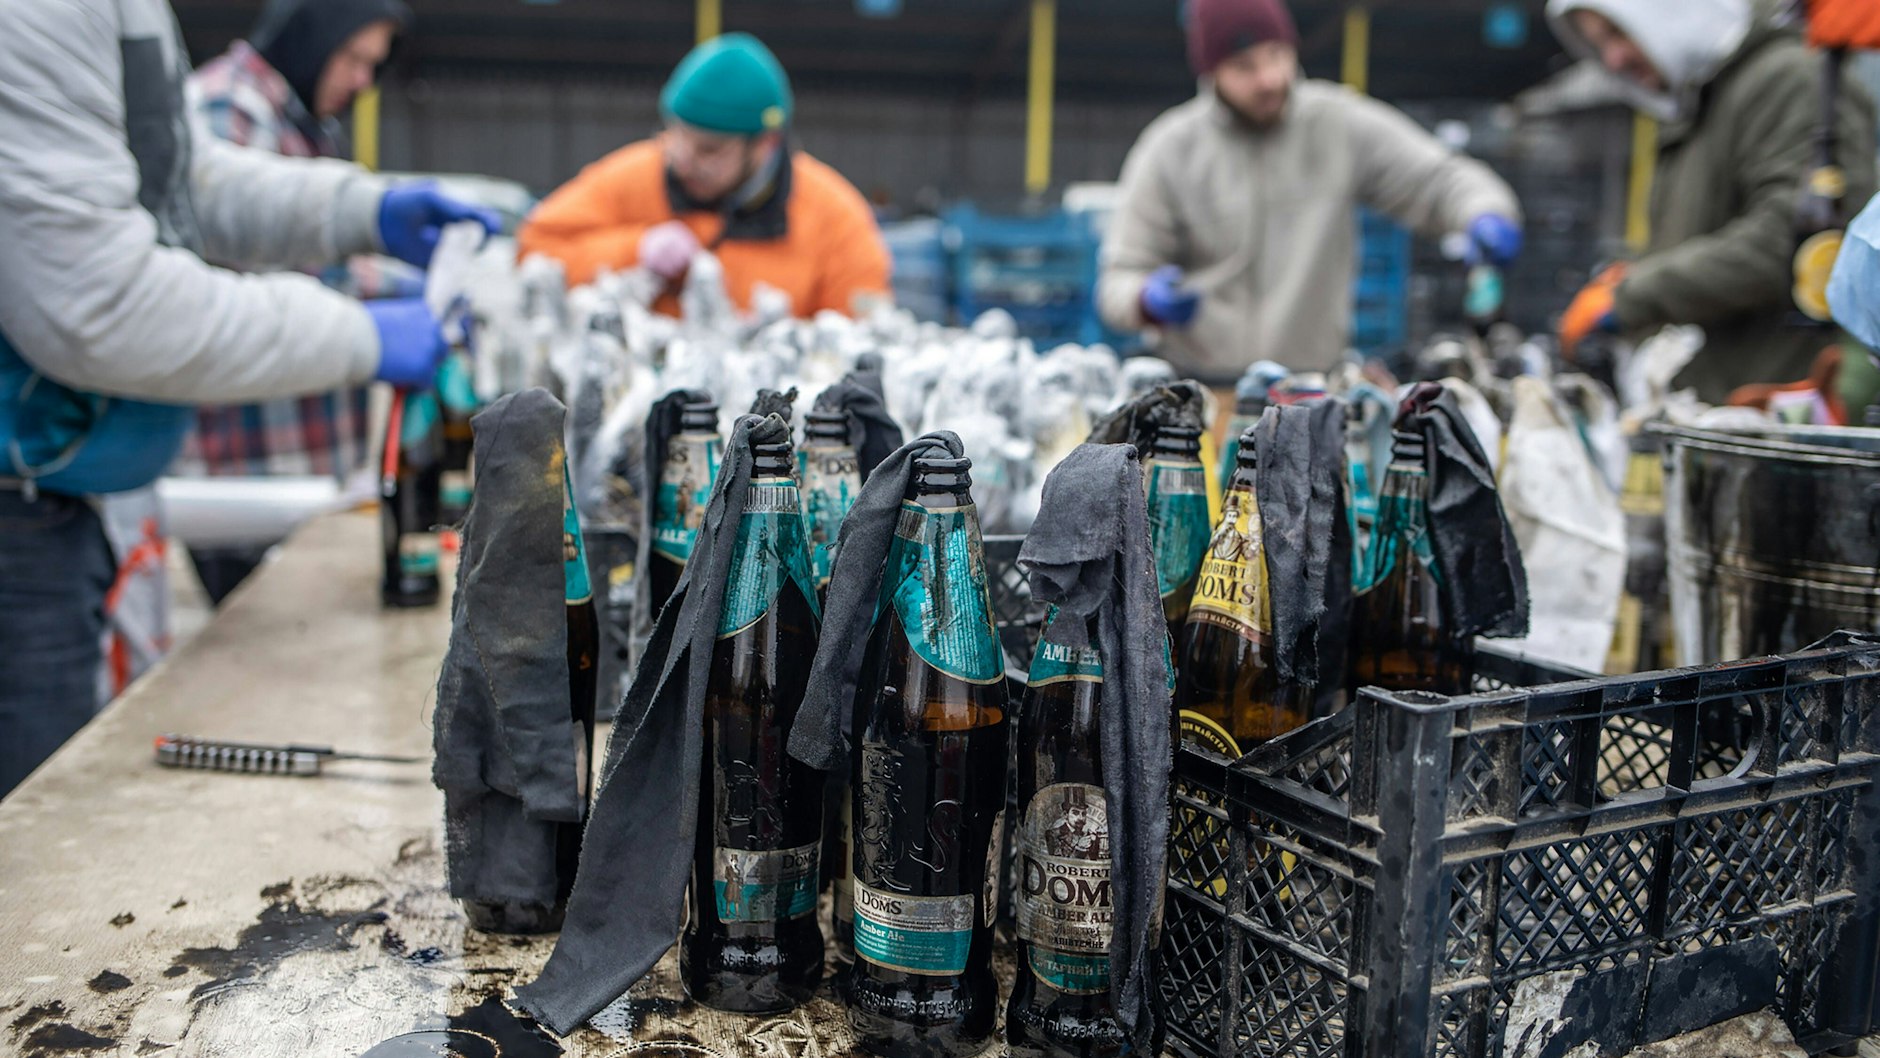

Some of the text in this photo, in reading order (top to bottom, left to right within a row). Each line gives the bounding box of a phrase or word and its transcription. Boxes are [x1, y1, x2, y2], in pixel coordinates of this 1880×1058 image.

[1021, 854, 1111, 907] DOM
[1046, 861, 1111, 878] ROBERT
[861, 888, 903, 915] DOMS
[860, 919, 886, 938] Amber
[887, 930, 905, 942] Ale
[1036, 959, 1093, 976] ТАРНИЙ
